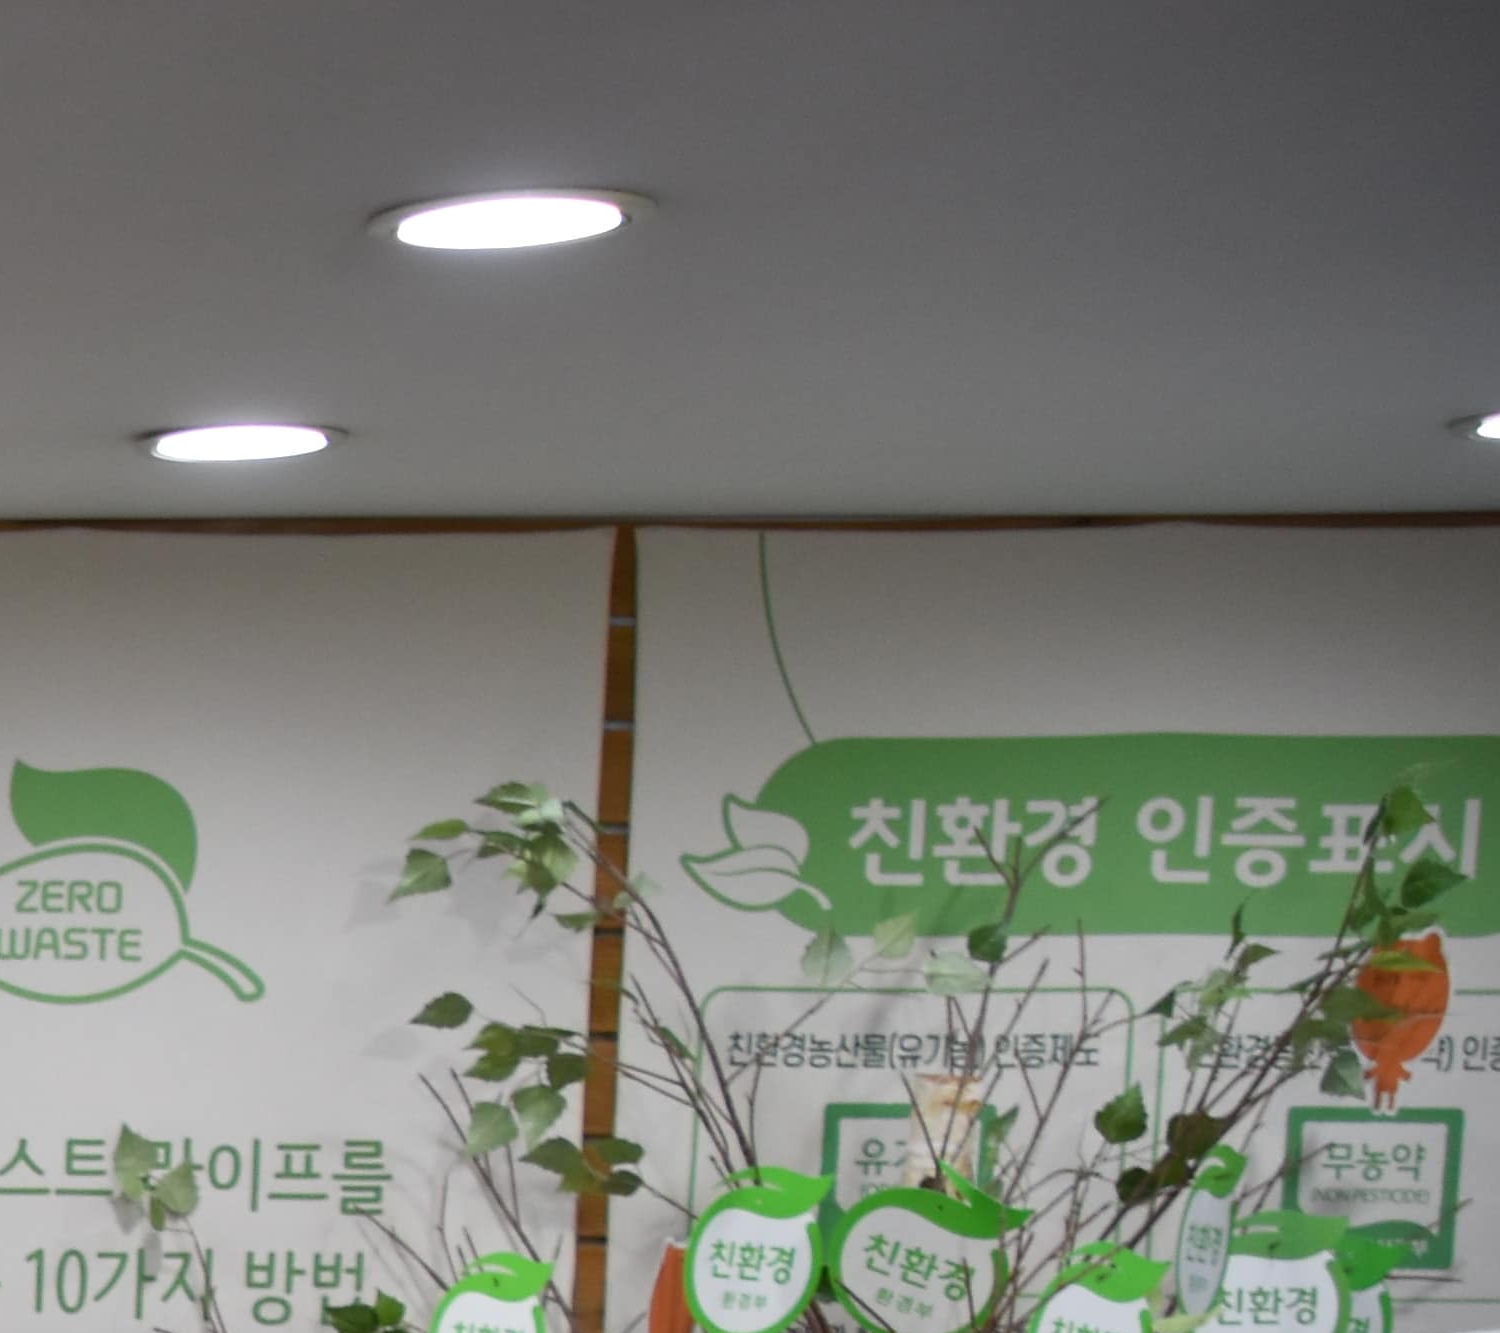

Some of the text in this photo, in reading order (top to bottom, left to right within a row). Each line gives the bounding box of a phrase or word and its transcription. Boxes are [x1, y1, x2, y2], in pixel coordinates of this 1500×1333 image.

[849, 795, 1483, 887] 친환경 인증표시
[14, 880, 122, 914] ZERO
[1321, 1141, 1428, 1183] 무농약
[709, 1239, 798, 1286] 친환경
[862, 1232, 976, 1306] 친환경
[24, 1248, 216, 1322] 10가지
[720, 1290, 769, 1311] 환경부
[874, 1287, 936, 1319] 환경부
[1214, 1286, 1318, 1326] 친환경
